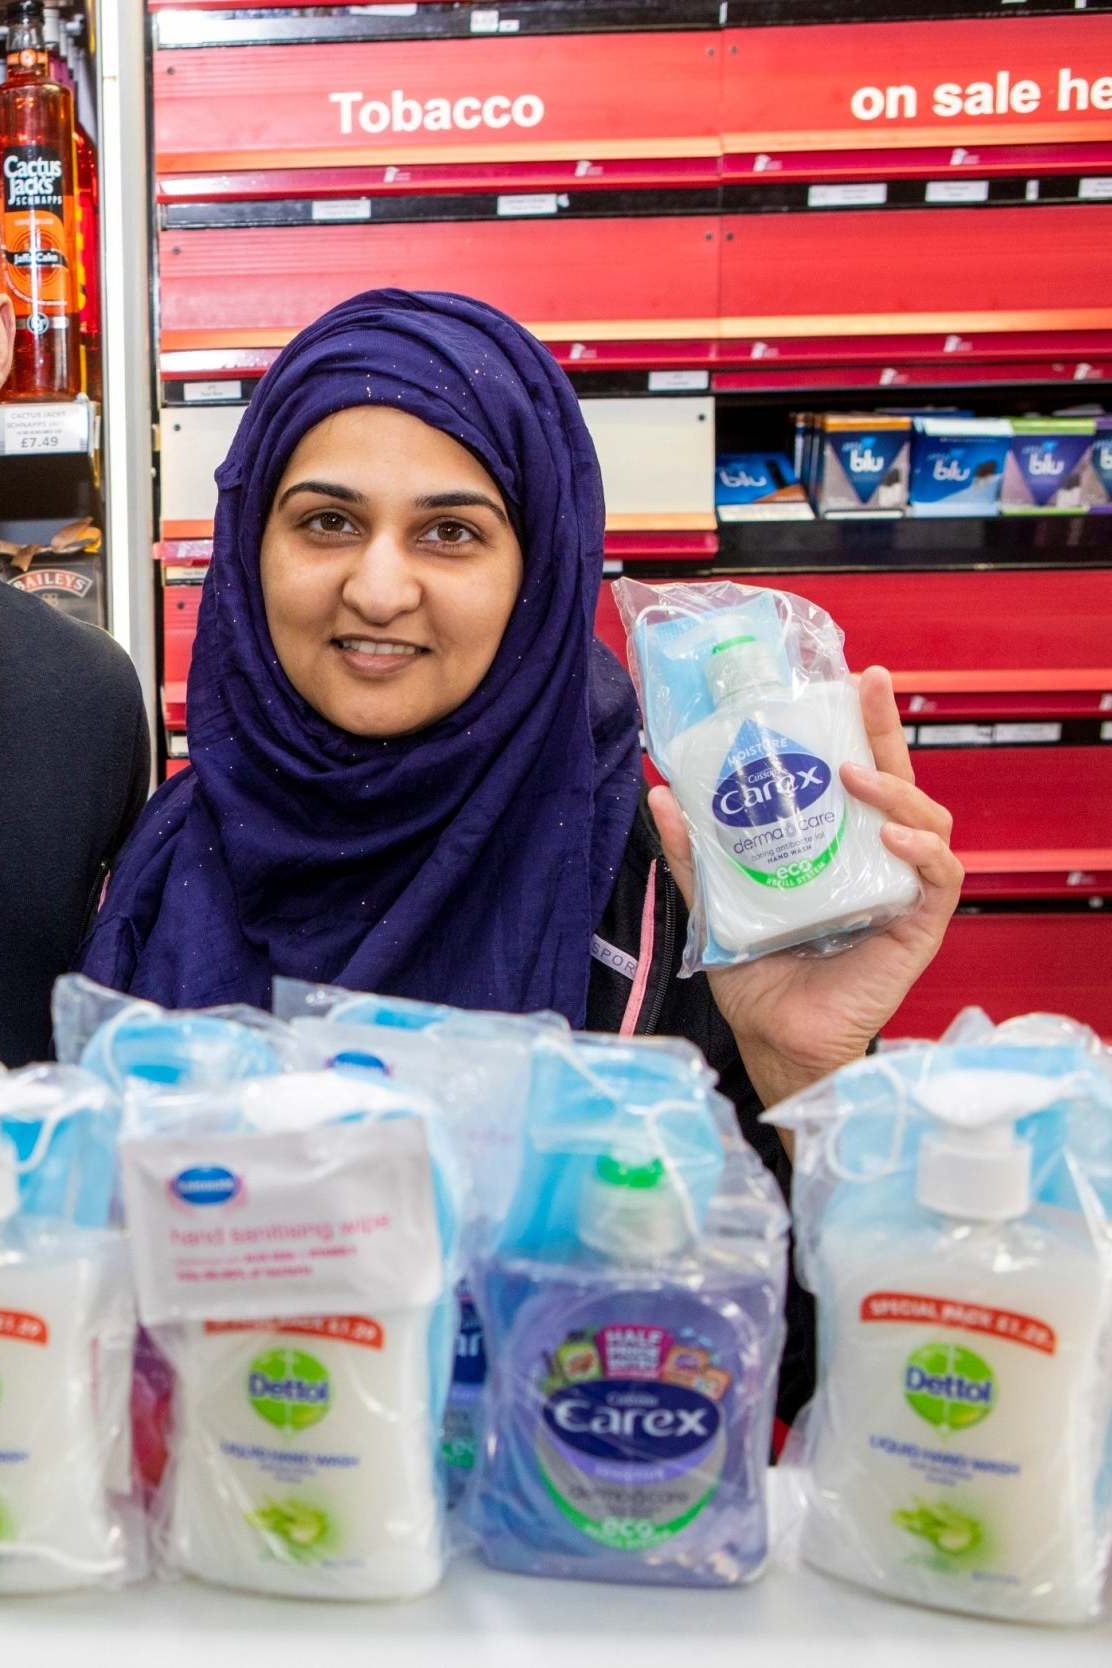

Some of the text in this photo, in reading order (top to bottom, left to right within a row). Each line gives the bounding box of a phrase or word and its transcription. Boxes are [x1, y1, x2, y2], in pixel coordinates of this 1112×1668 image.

[851, 68, 1112, 120] on sale he
[328, 89, 545, 135] Tobacco
[4, 155, 62, 179] Cactus
[21, 437, 59, 449] £7.49
[850, 449, 884, 473] blu
[933, 459, 970, 482] blu
[1028, 452, 1065, 476] blu
[720, 470, 767, 488] blu
[728, 737, 789, 766] MOISTURE
[720, 766, 824, 815] Carex
[733, 811, 835, 854] derma care
[768, 844, 812, 864] HAND WASH
[776, 860, 812, 880] eco
[591, 942, 636, 975] SPOR
[248, 1373, 329, 1403] Dettol
[904, 1364, 993, 1403] Dettol
[554, 1400, 708, 1437] Carex
